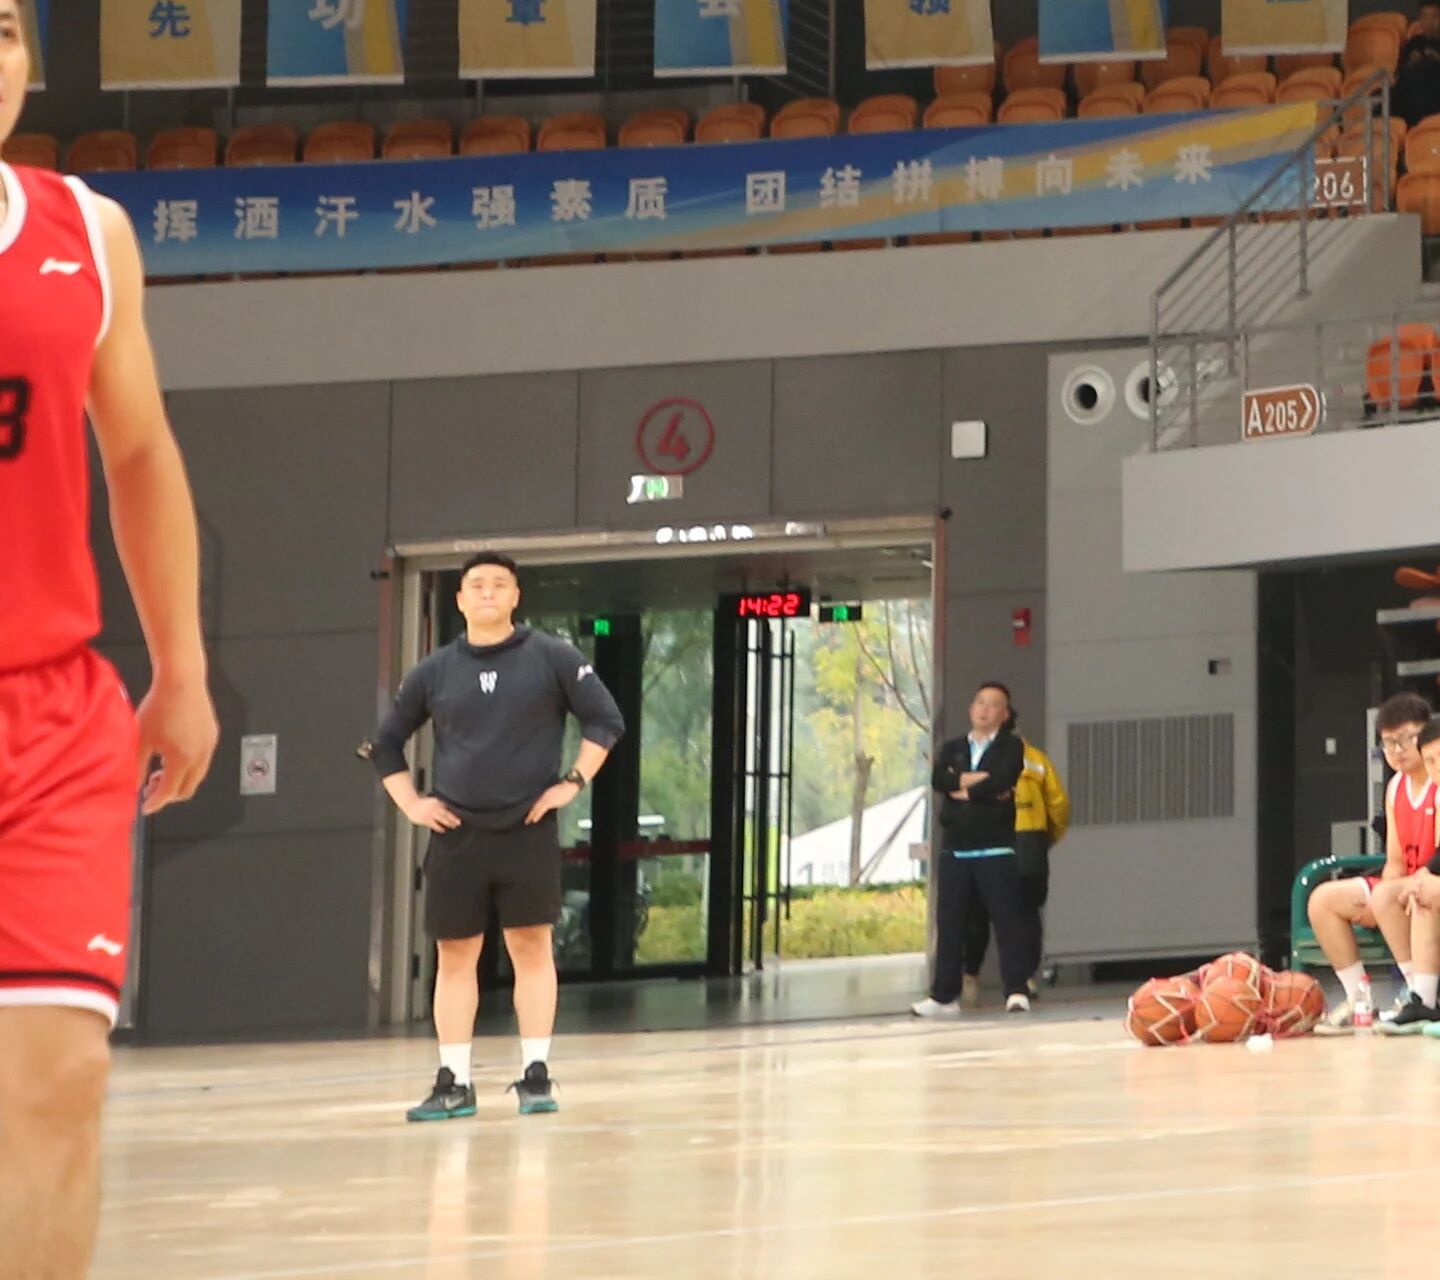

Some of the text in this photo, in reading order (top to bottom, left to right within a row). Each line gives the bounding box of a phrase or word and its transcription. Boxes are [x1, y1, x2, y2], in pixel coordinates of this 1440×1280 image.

[152, 143, 1213, 243] 挥洒汗水强素质 团结拼搏向未来
[656, 411, 690, 462] 4
[1245, 397, 1298, 435] A205
[739, 593, 799, 617] 14:22
